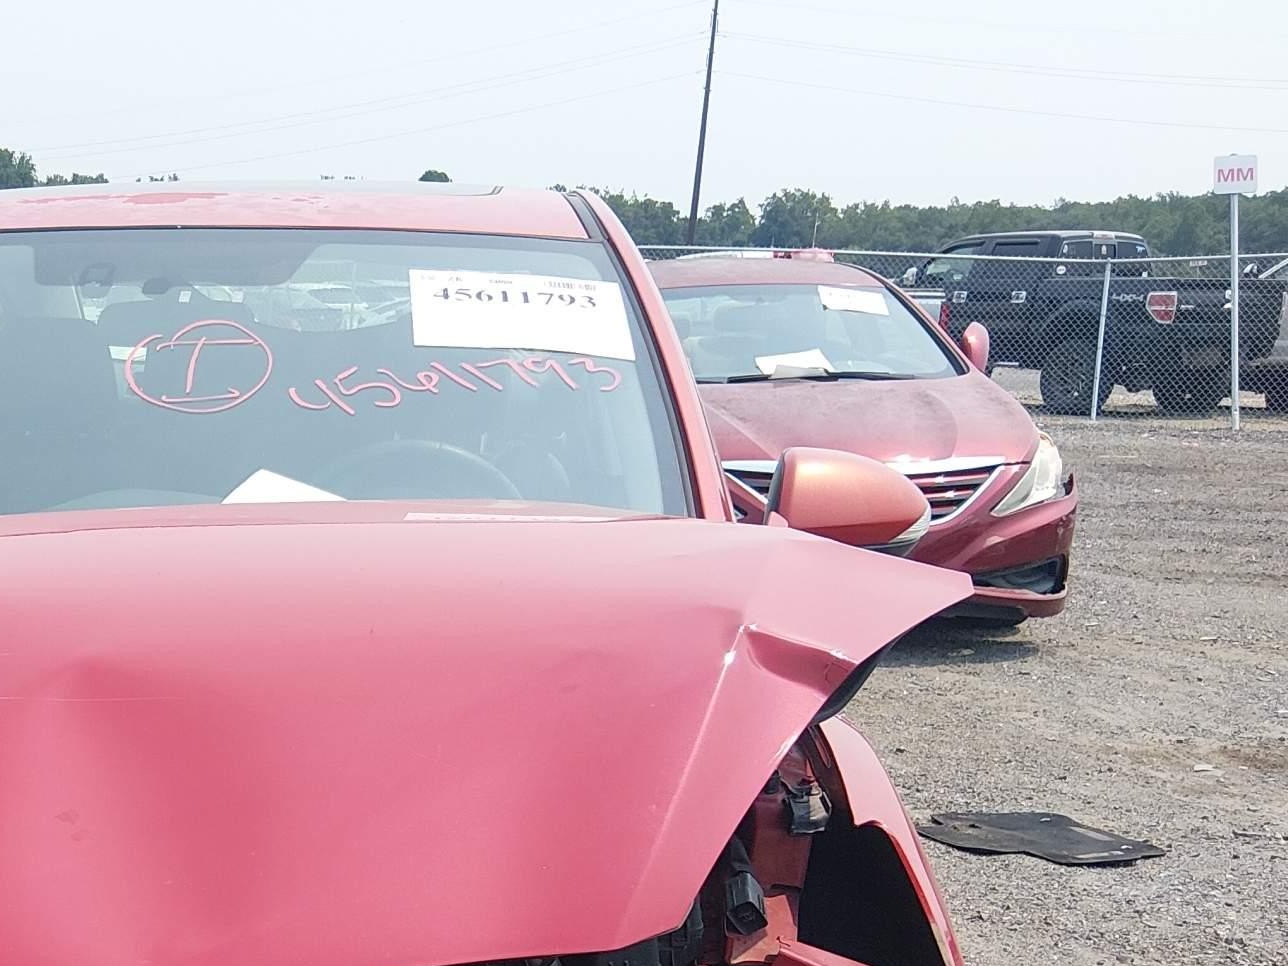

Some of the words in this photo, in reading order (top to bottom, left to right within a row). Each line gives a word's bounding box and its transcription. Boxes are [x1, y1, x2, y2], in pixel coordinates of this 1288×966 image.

[1217, 167, 1254, 183] MM
[432, 287, 597, 309] 45611793
[288, 356, 622, 416] 45611793
